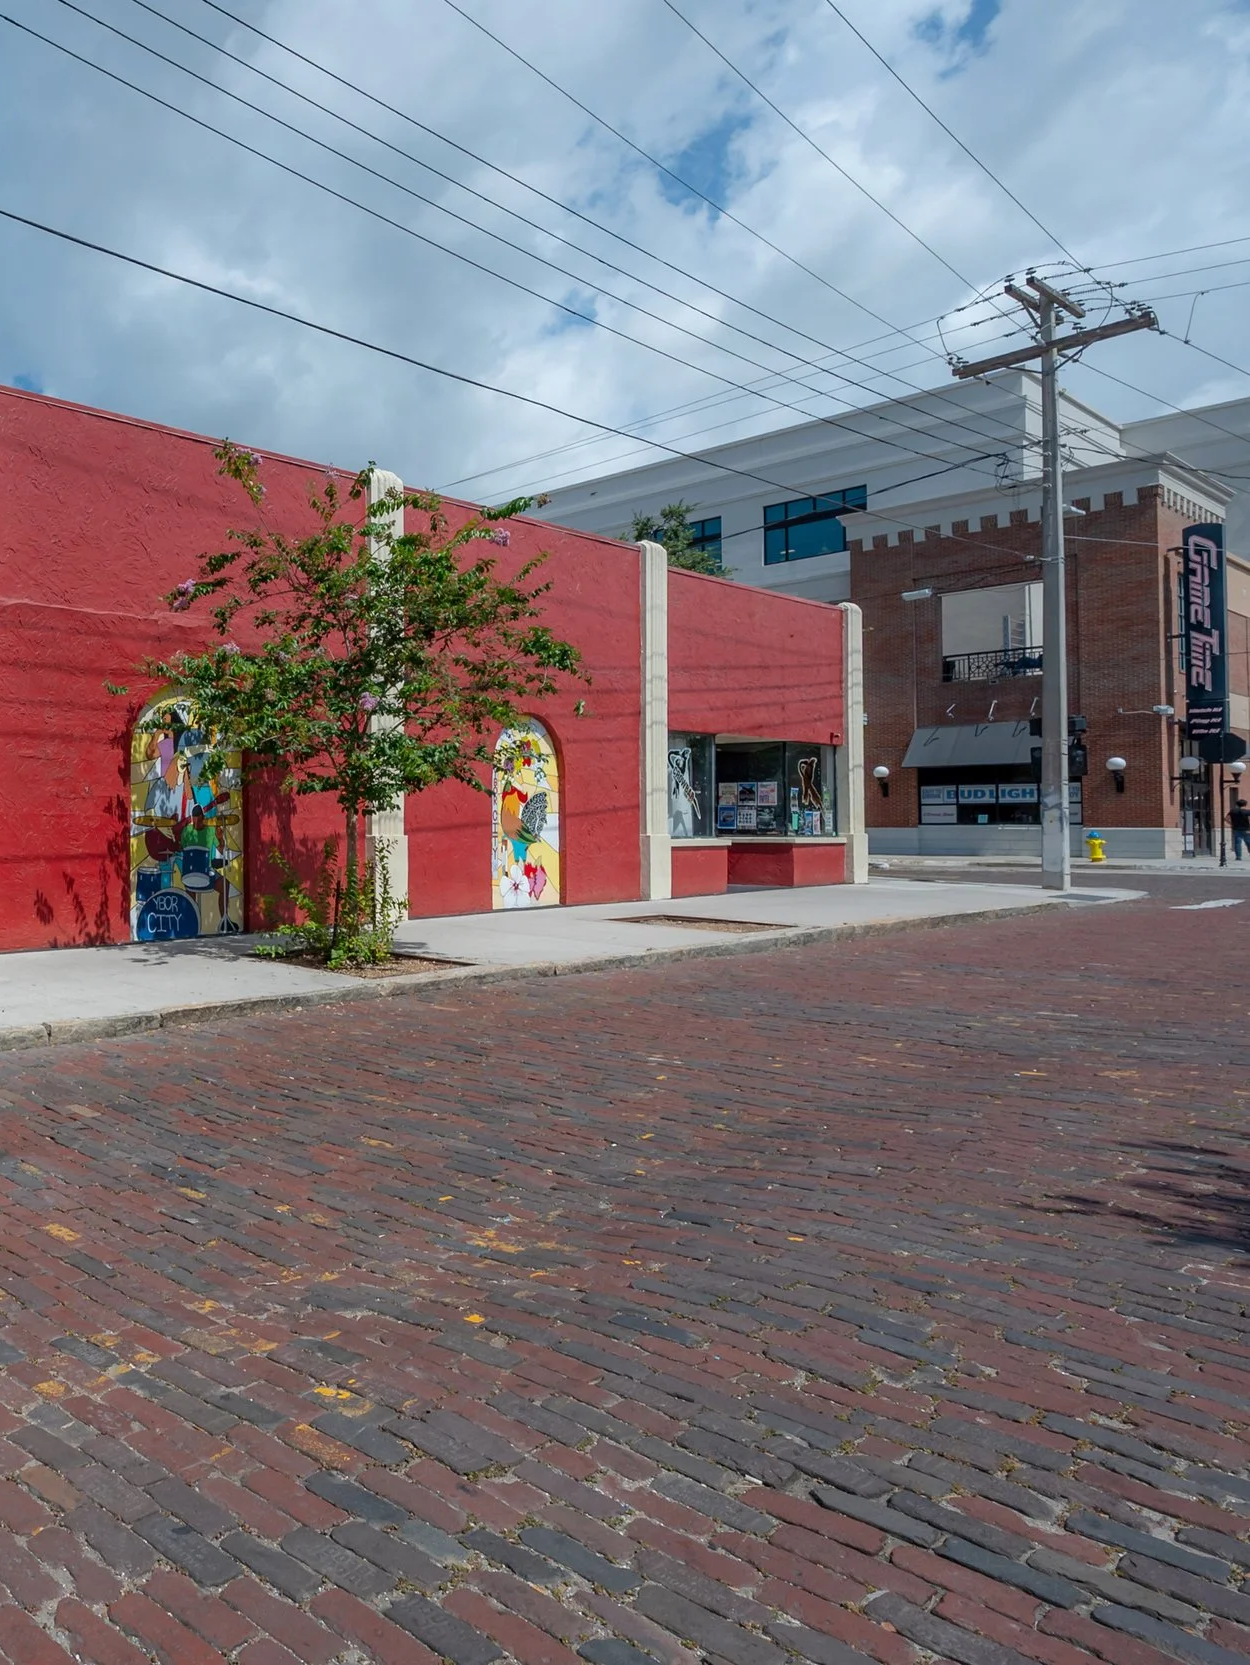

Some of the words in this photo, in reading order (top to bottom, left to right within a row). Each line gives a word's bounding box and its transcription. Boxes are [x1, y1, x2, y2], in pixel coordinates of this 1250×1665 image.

[1188, 534, 1218, 629] GAME
[1190, 628, 1220, 692] TIME
[946, 788, 986, 800] BUD
[989, 788, 1036, 800] LIGH
[153, 896, 178, 912] YBOR
[147, 912, 182, 933] CITY
